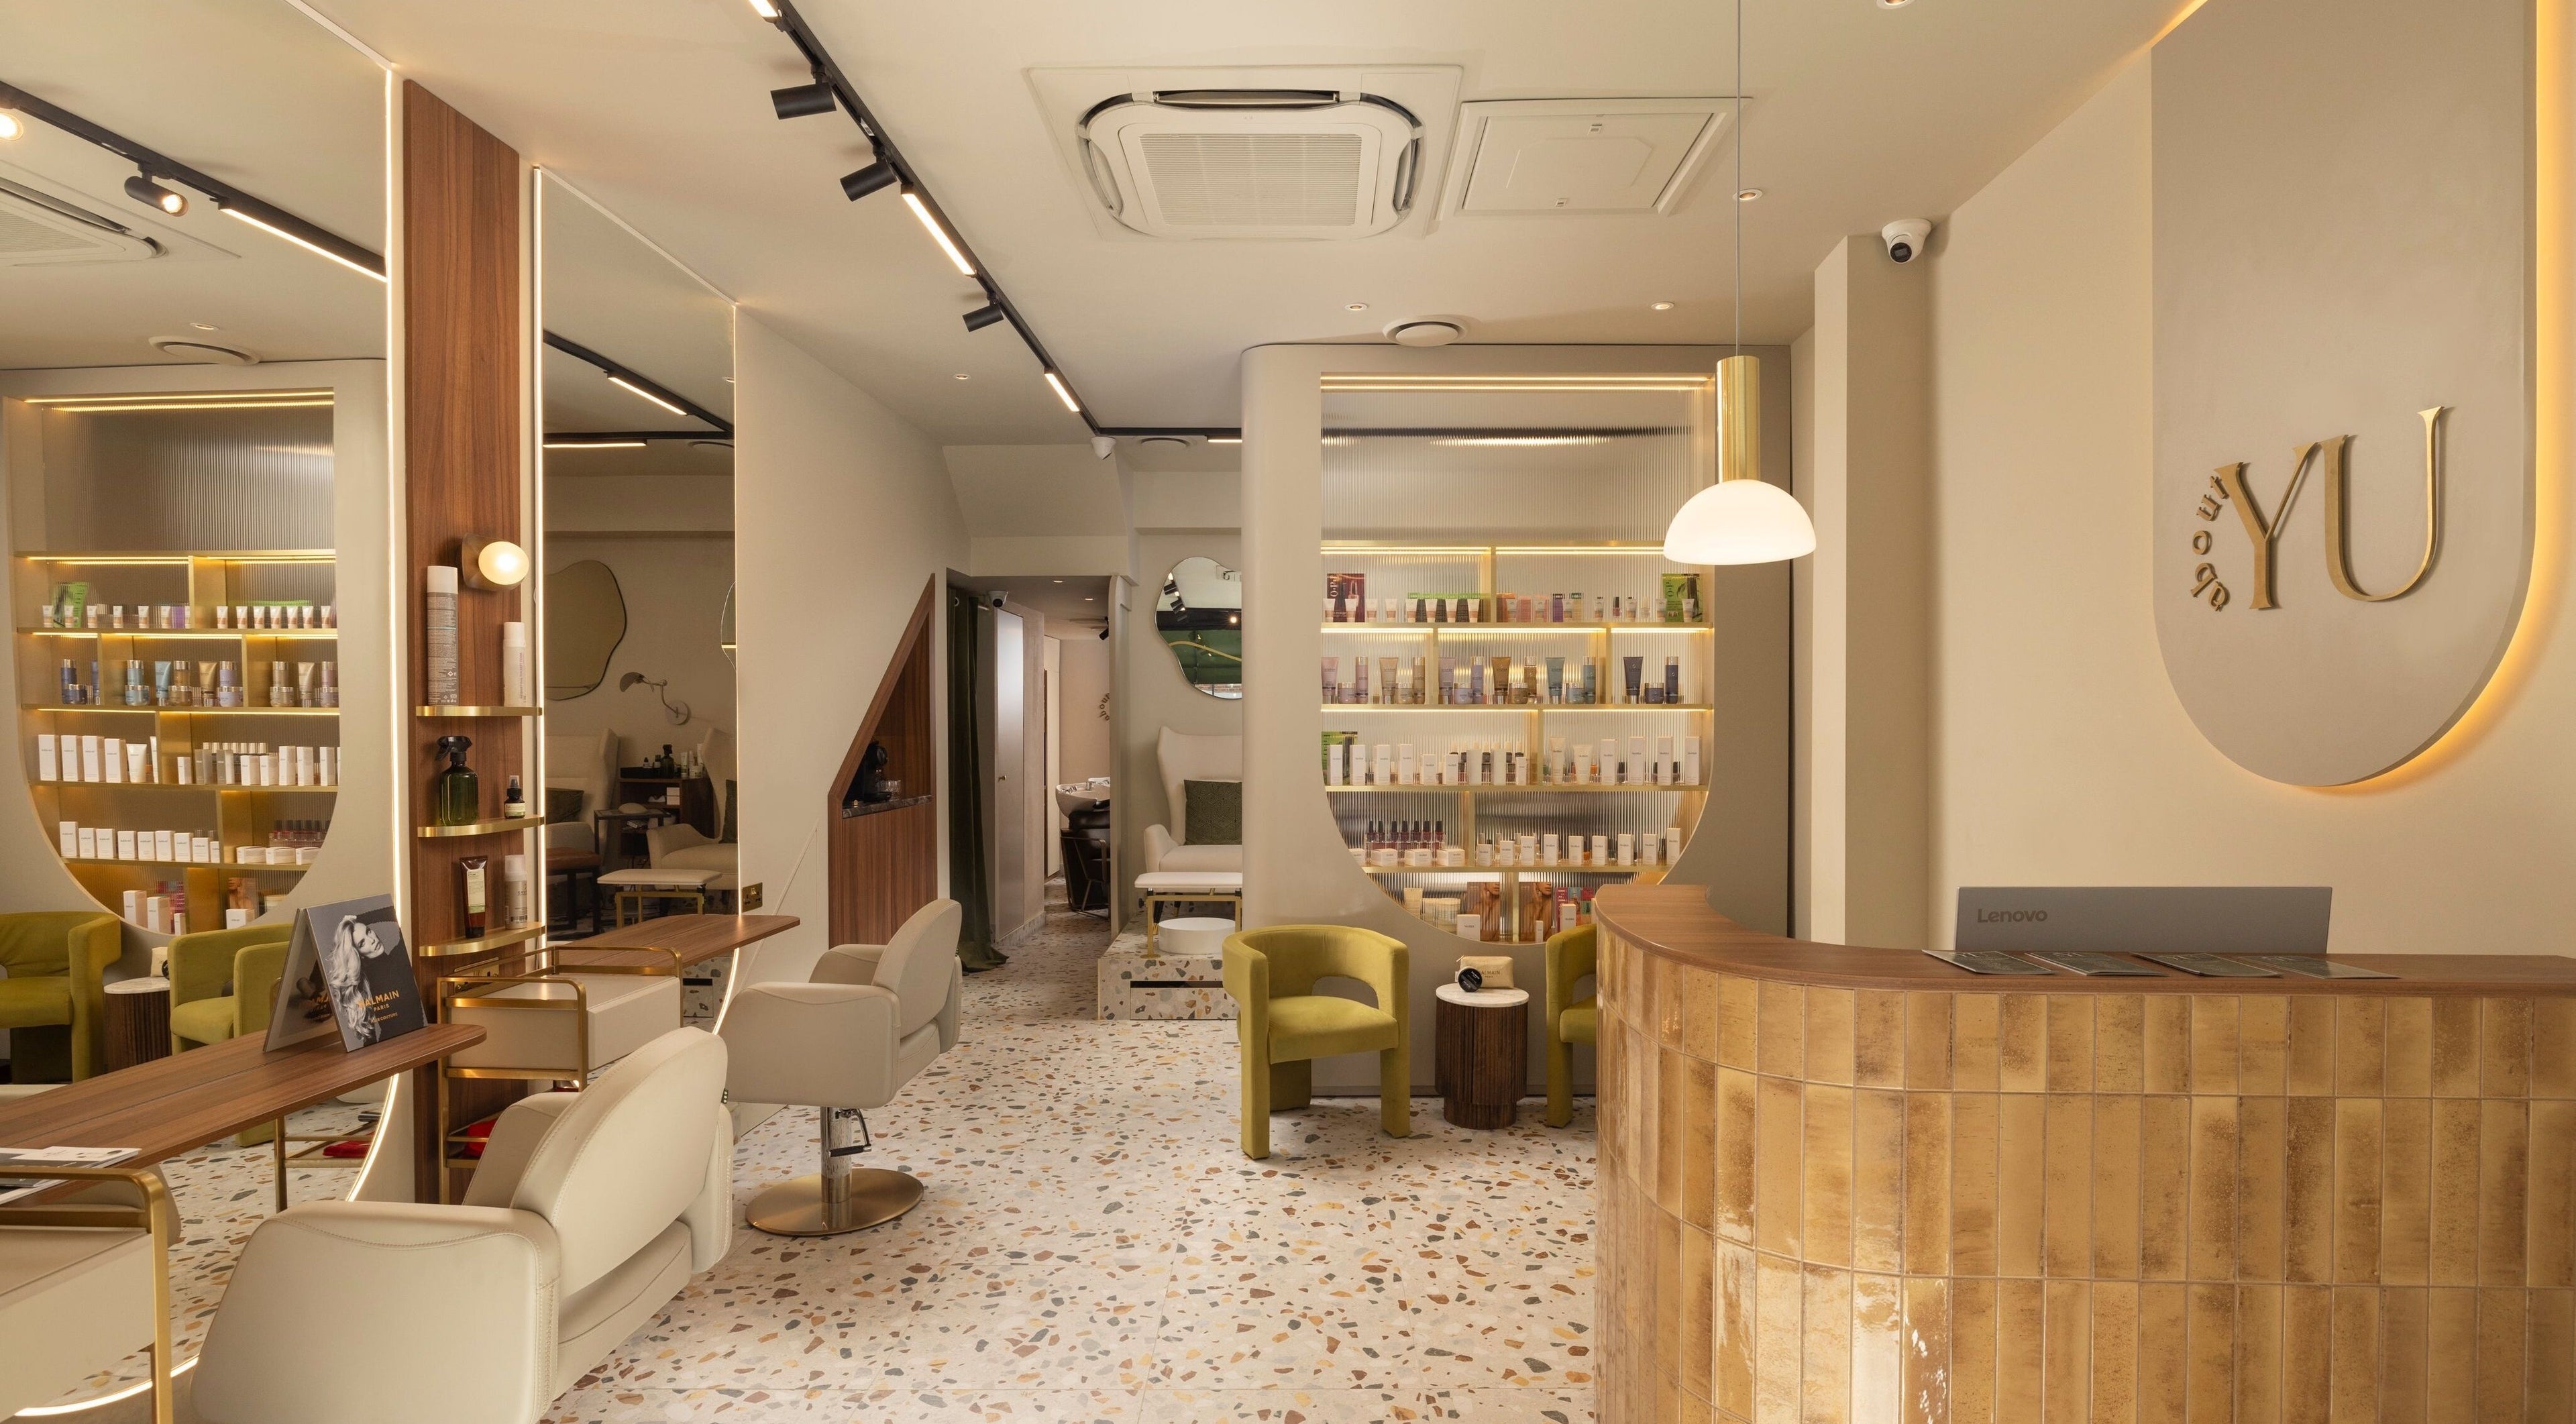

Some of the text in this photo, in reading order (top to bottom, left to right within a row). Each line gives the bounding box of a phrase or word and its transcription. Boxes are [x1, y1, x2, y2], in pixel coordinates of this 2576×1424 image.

[2190, 476, 2230, 612] about
[2214, 405, 2445, 610] YU
[1977, 908, 2048, 923] Lenovo
[373, 1003, 390, 1011] PARIS
